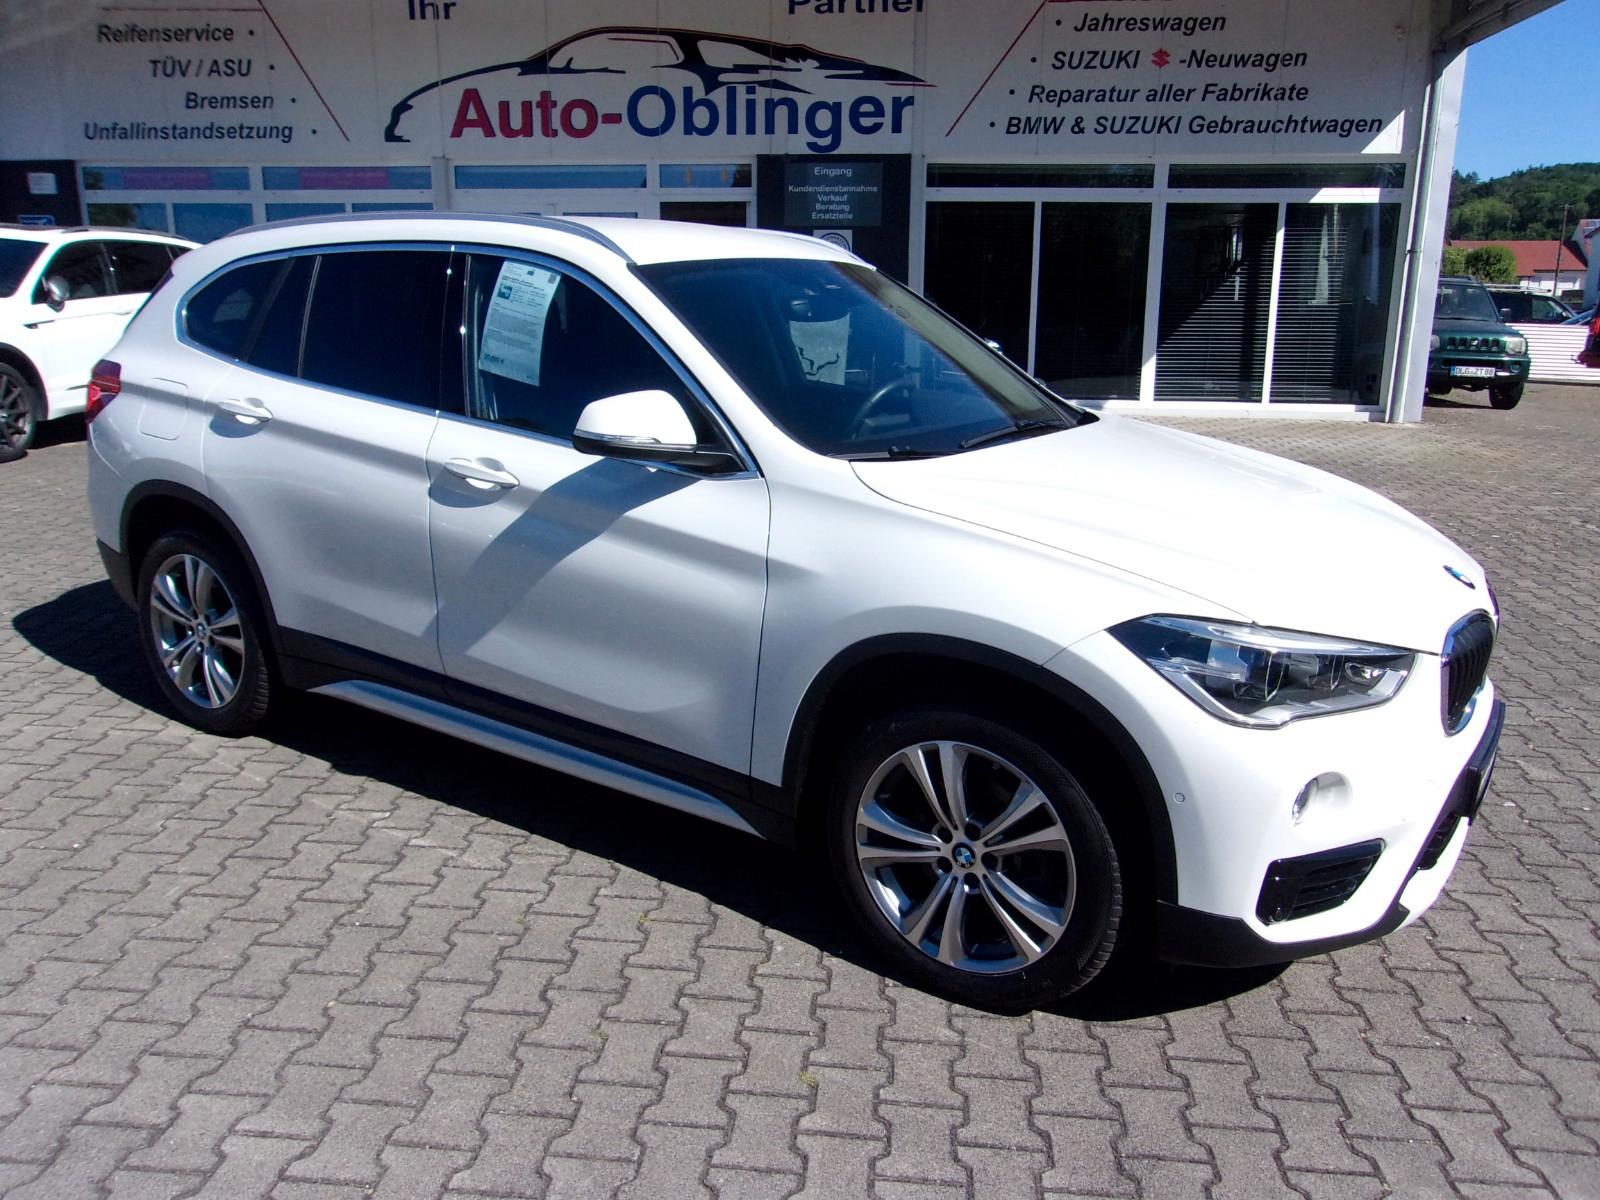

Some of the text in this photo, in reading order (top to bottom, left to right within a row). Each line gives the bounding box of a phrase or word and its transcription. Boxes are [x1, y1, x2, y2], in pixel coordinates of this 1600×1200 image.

[408, 0, 456, 20] Ihr
[97, 24, 234, 43] Reifenservice
[1073, 13, 1226, 36] Jahreswagen
[149, 56, 191, 77] TÜV
[207, 59, 252, 77] ASU
[1051, 49, 1308, 72] SUZUKI -Neuwagen
[184, 92, 274, 109] Bremsen
[1028, 83, 1309, 108] Reparatur aller Fabrikate
[450, 84, 915, 153] Auto-Oblinger
[1005, 115, 1383, 138] BMW & SUZUKI Gebrauchtwagen
[84, 122, 293, 143] Unfallinstandsetzung
[814, 167, 852, 177] Eingang
[815, 203, 850, 212] Beratung
[817, 194, 848, 202] Verkauf
[811, 211, 854, 220] Ersatzteile
